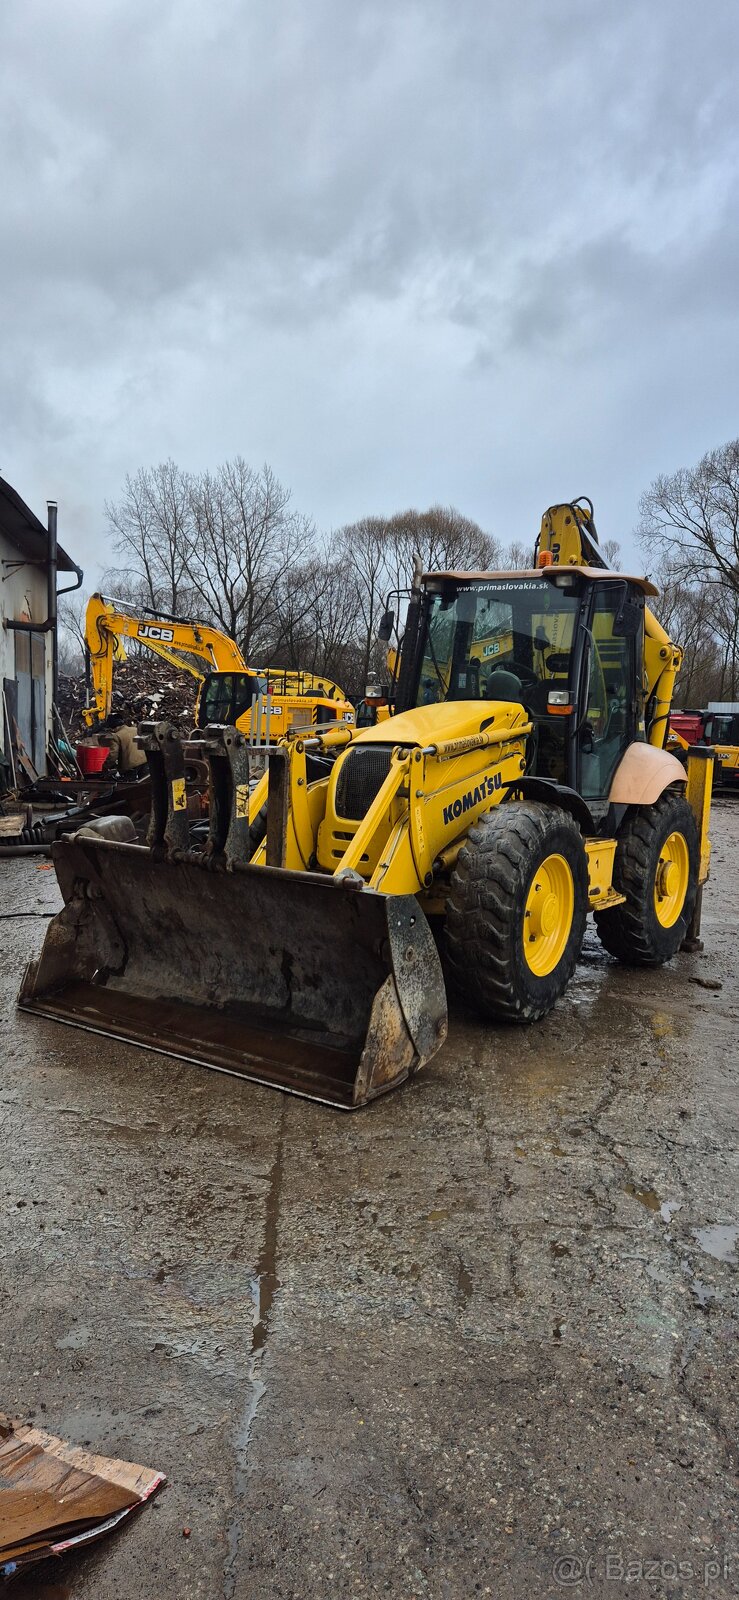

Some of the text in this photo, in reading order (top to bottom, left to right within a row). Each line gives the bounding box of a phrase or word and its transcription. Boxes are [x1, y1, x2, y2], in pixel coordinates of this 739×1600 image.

[456, 582, 549, 592] www.primaslovakia.sk
[138, 626, 173, 642] JCB
[483, 643, 500, 656] JCB
[442, 772, 502, 825] KOMATSU
